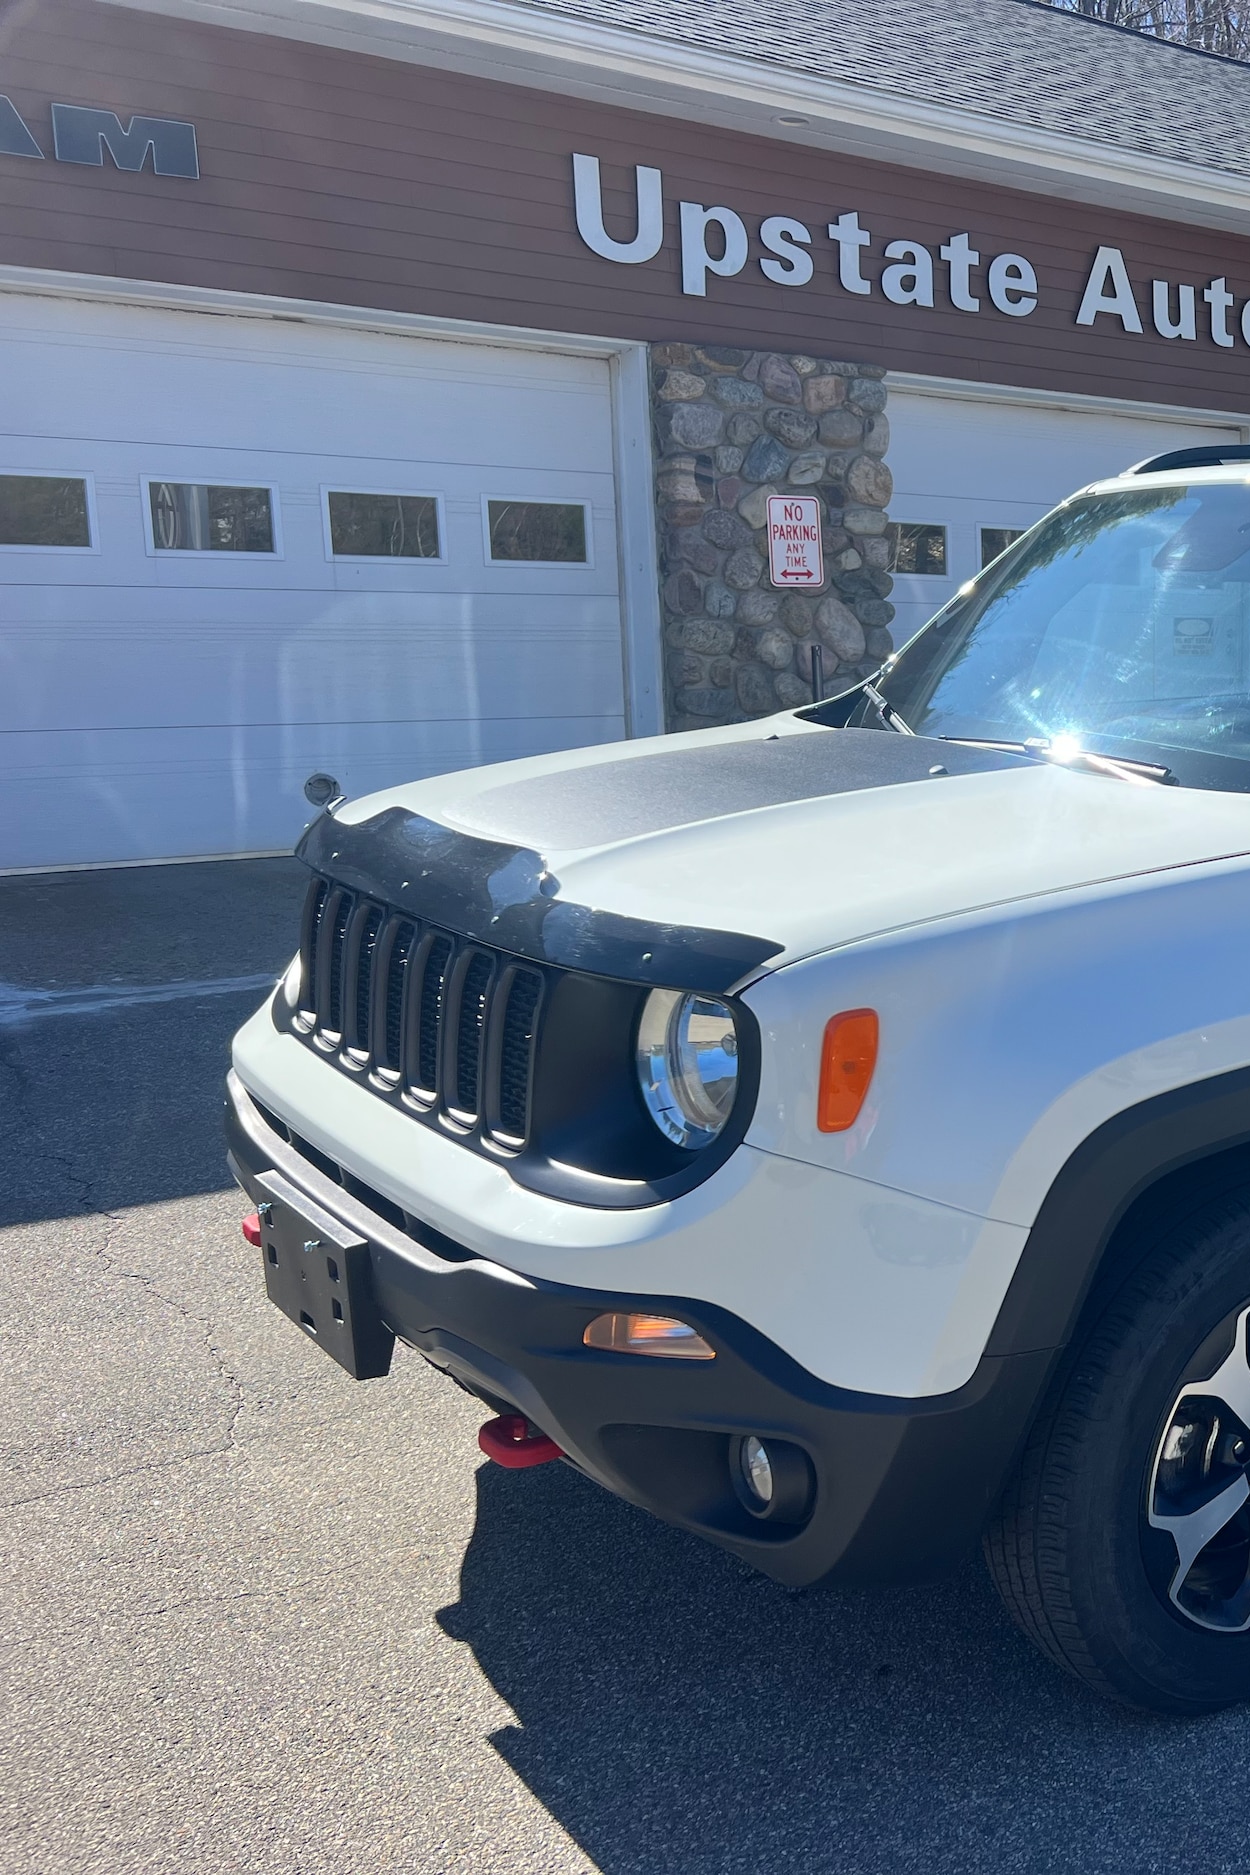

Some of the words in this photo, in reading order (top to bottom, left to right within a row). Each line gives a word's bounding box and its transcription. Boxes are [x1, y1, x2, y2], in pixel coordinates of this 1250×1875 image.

[572, 152, 1038, 317] Upstate
[784, 505, 803, 522] NO
[772, 524, 817, 541] PARKING
[786, 543, 805, 554] ANY
[785, 556, 807, 567] TIME
